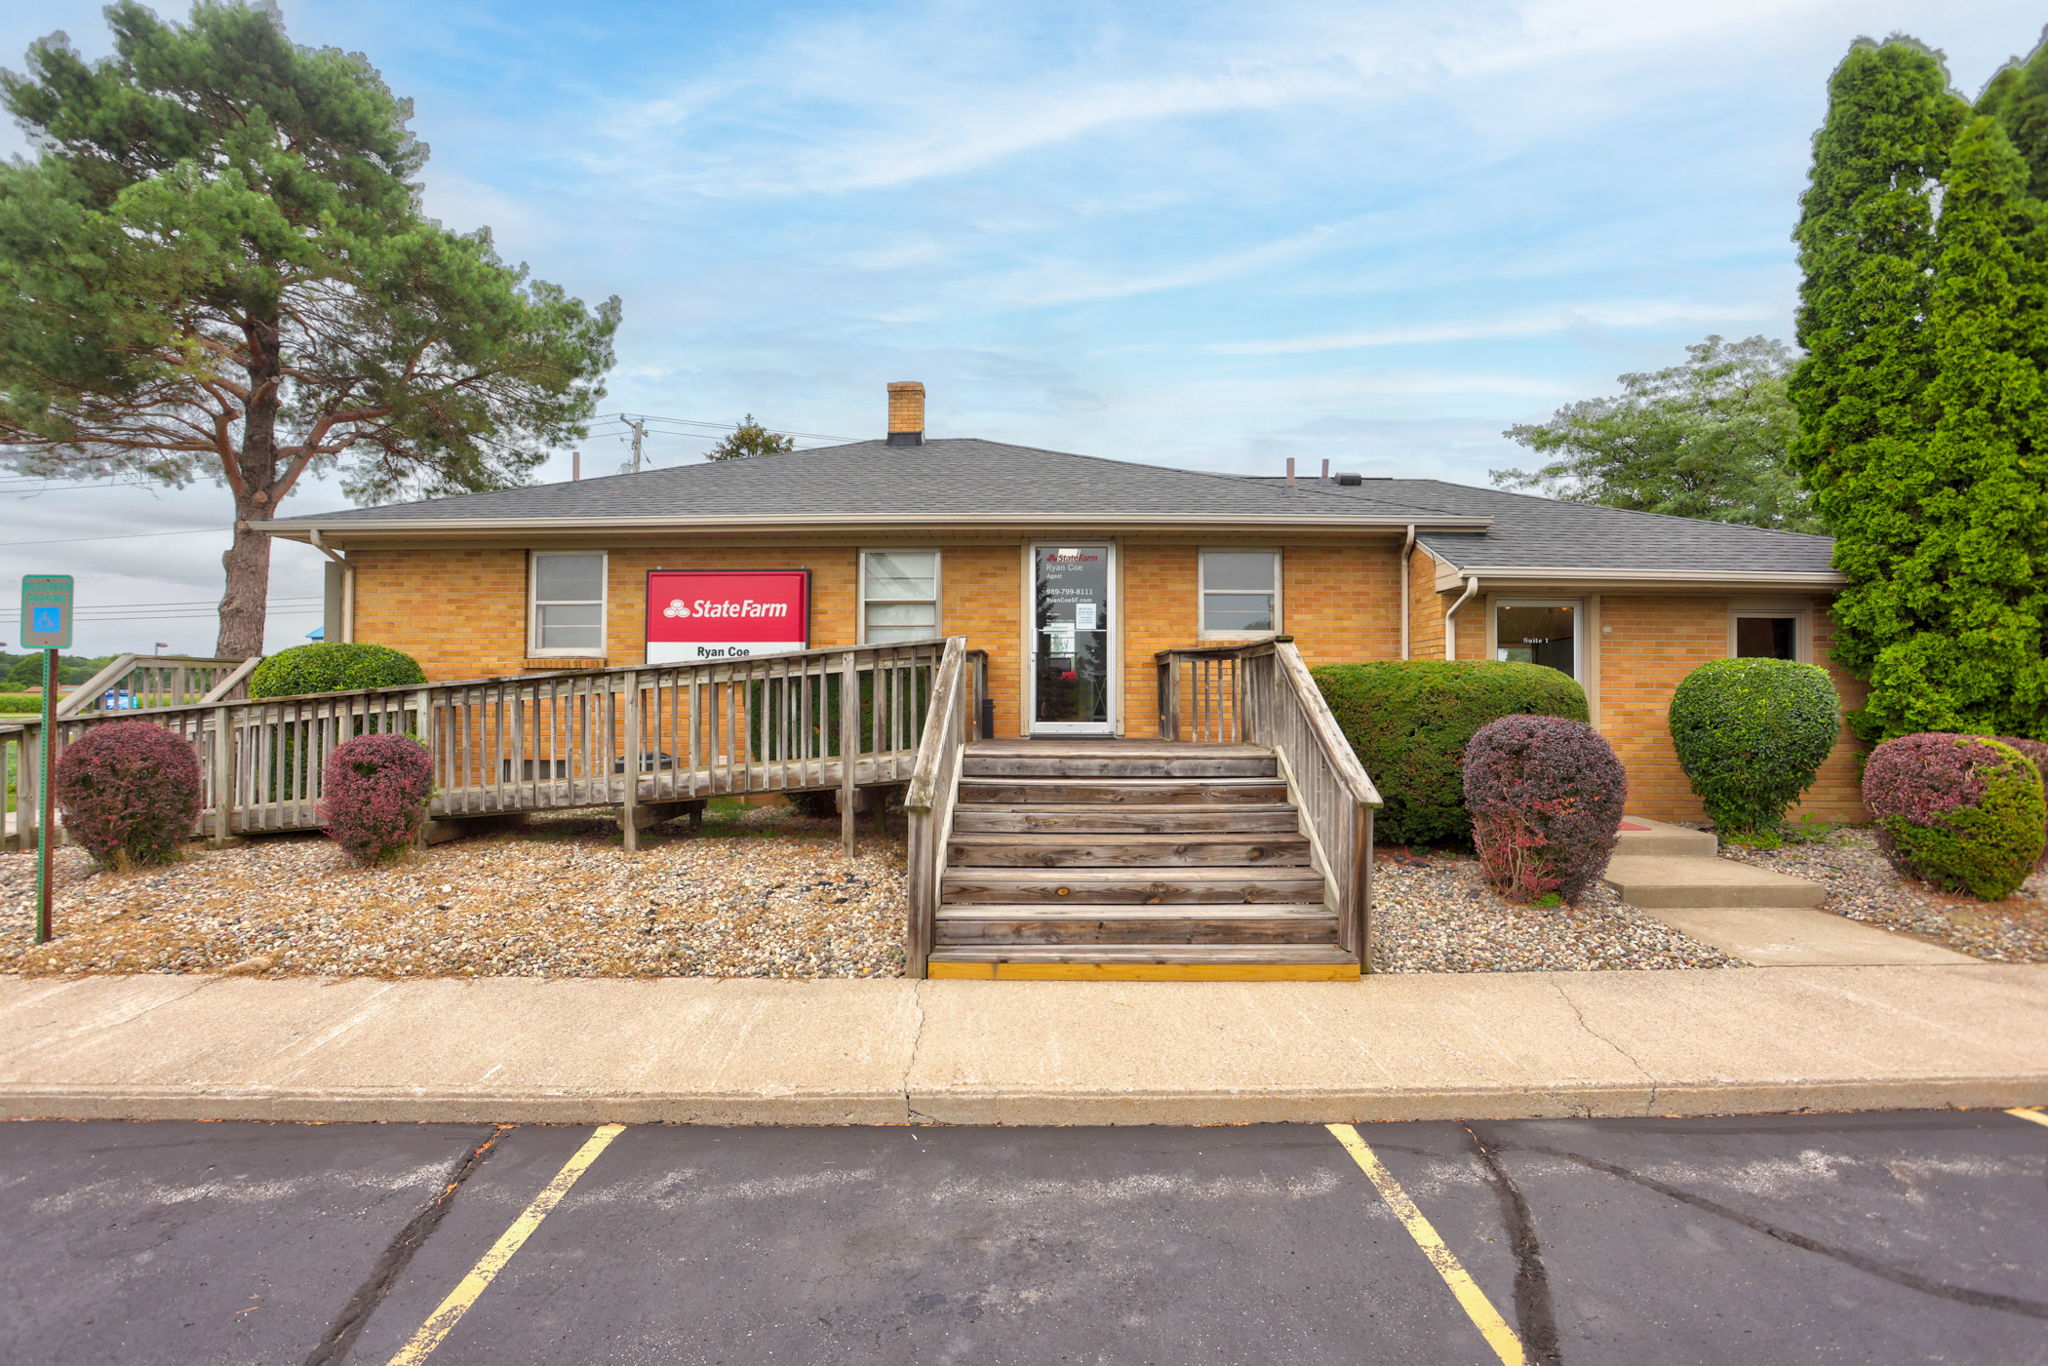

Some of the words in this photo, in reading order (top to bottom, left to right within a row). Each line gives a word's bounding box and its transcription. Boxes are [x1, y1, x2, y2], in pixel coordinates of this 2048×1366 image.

[1046, 563, 1066, 572] Ryan
[1068, 563, 1083, 571] Coe
[1522, 636, 1543, 644] Suite
[697, 646, 725, 659] Ryan
[728, 646, 750, 657] Coe
